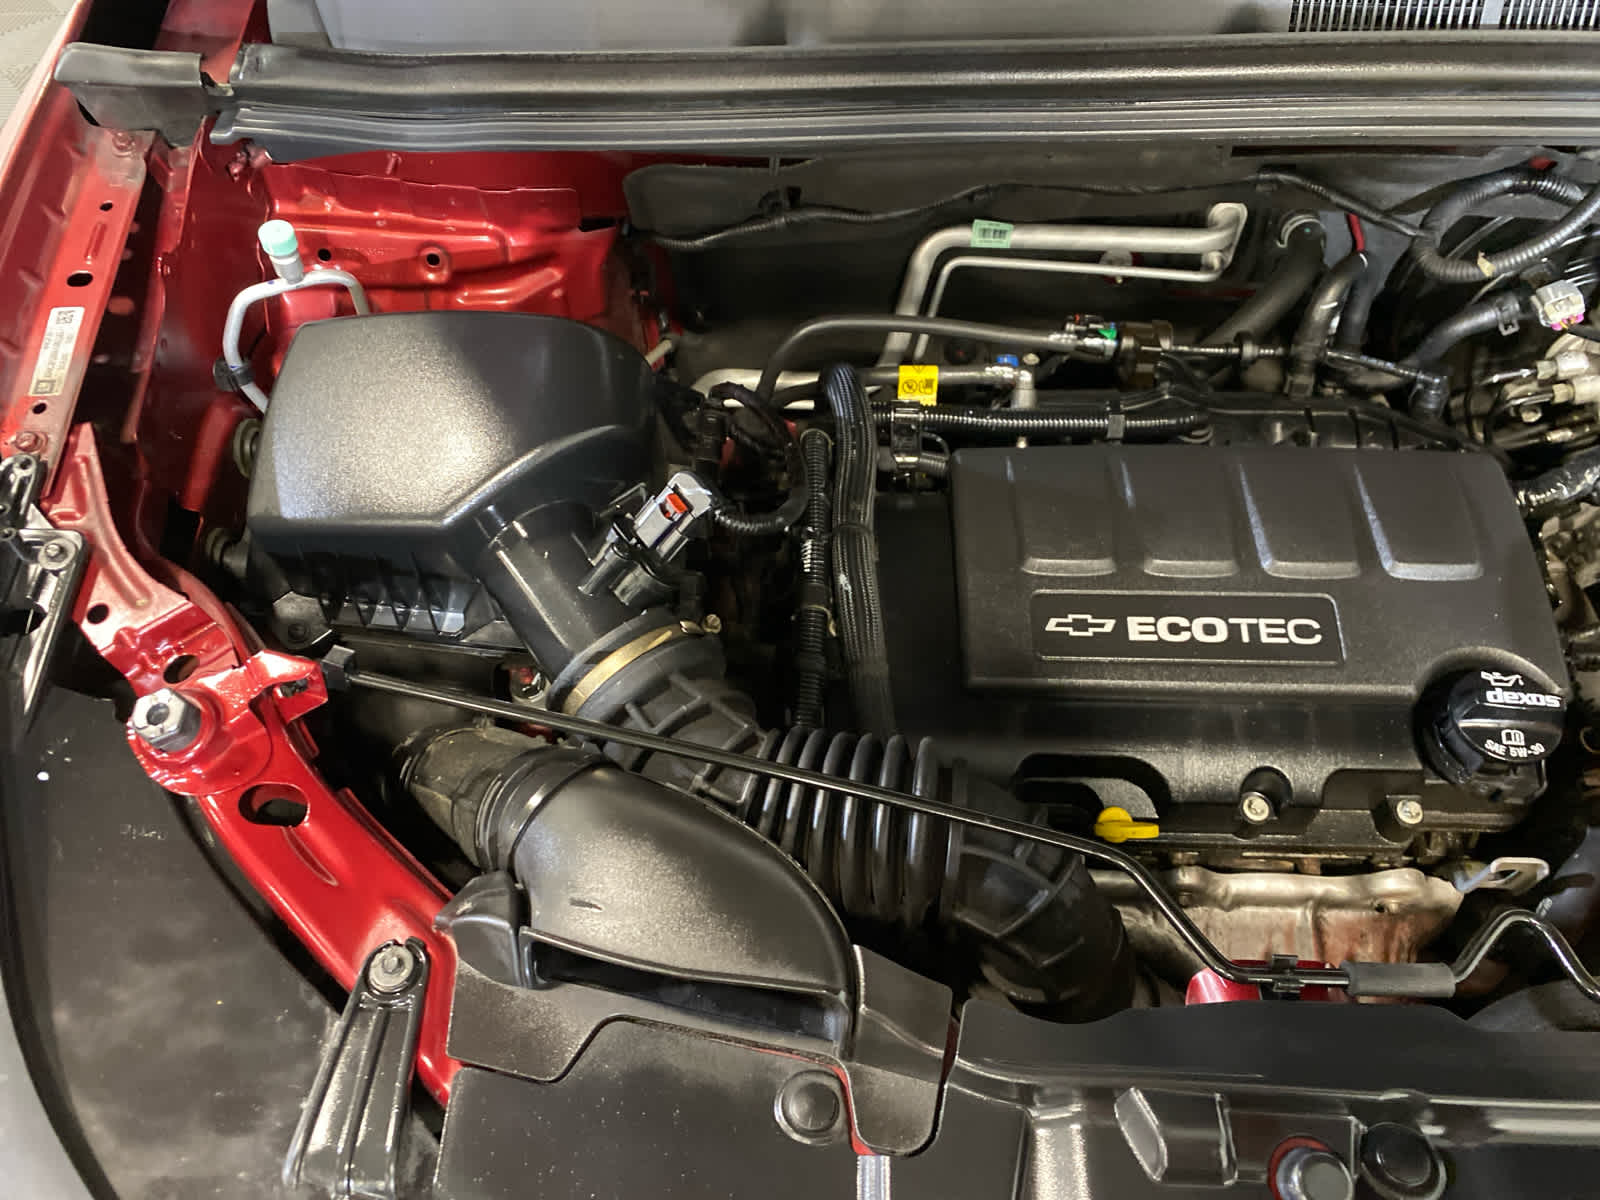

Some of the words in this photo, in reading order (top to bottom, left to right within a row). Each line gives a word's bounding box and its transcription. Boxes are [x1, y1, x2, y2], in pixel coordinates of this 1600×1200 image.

[1126, 616, 1322, 645] ECOTEC
[1486, 687, 1562, 708] dexos
[1484, 739, 1507, 755] SAE
[1509, 743, 1545, 757] 5W-30
